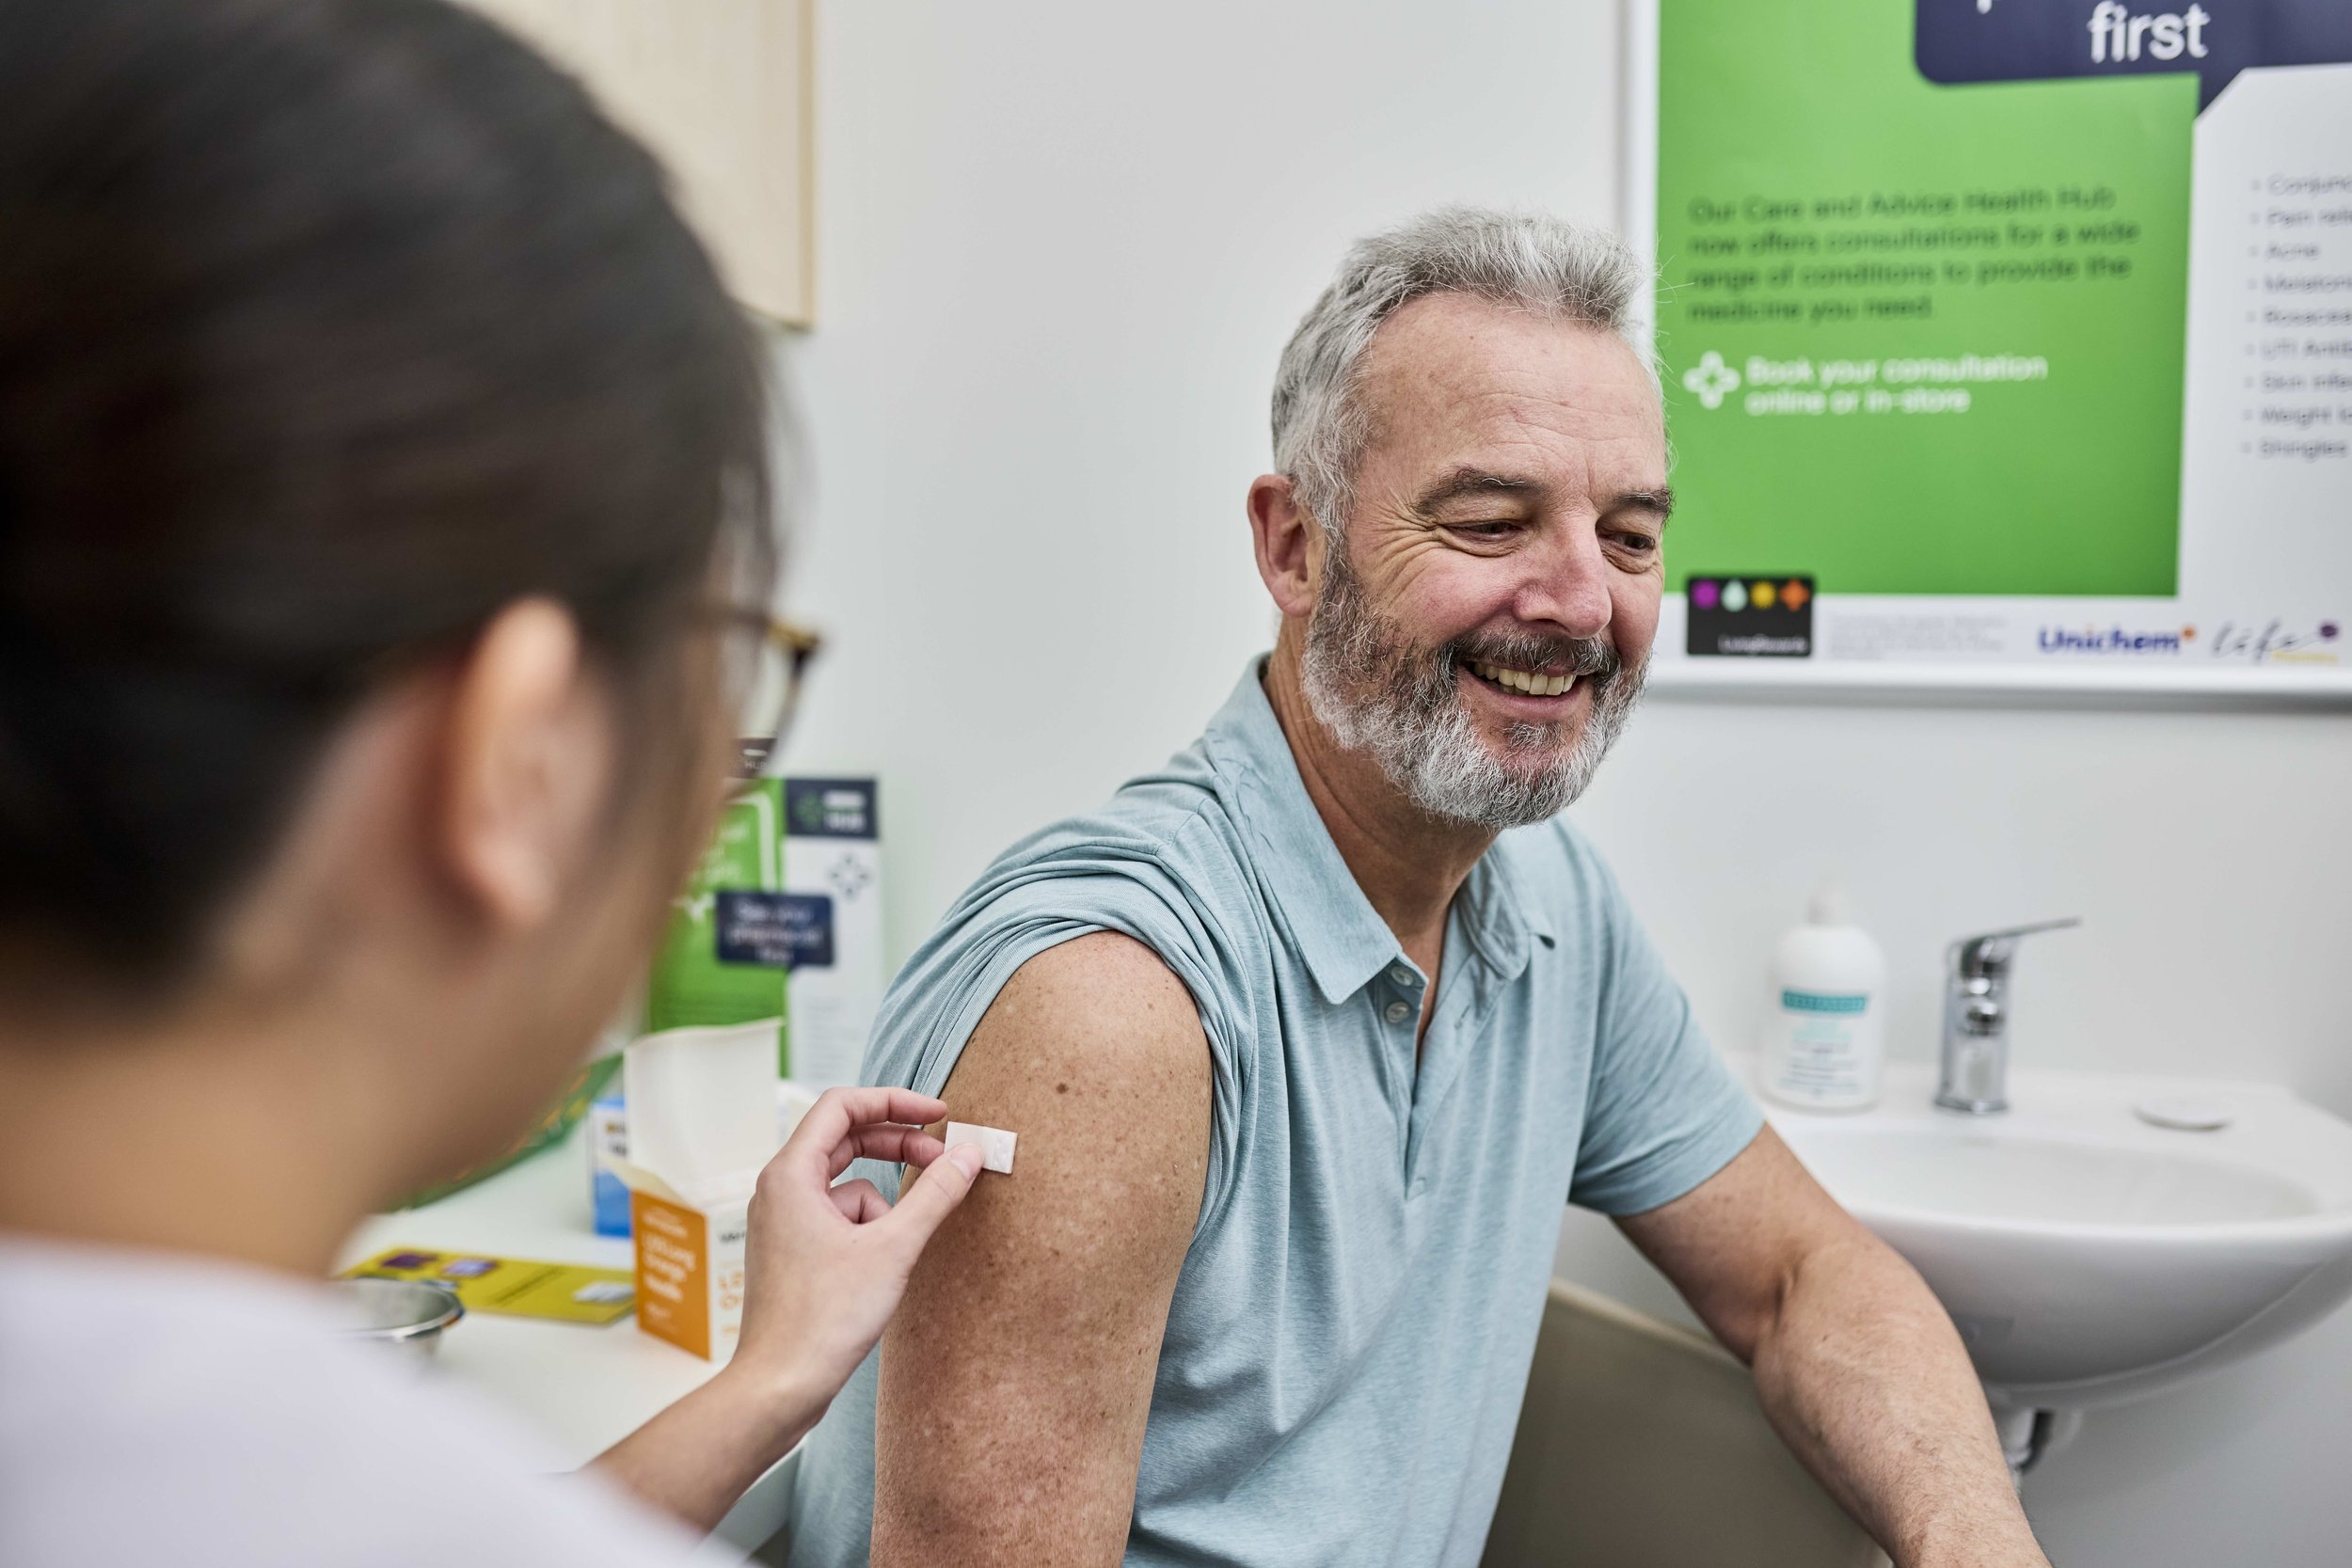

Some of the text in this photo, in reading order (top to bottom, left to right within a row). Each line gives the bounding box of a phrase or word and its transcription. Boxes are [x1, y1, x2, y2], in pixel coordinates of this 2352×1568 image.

[2087, 0, 2211, 64] first
[1689, 184, 2116, 224] Our Care and Advice Health Hub
[1825, 227, 2000, 254] consultations
[2007, 219, 2044, 248] for
[2076, 219, 2140, 245] wide
[1798, 261, 1936, 287] conditions
[1978, 258, 2080, 287] provide
[2085, 255, 2133, 280] the
[1745, 352, 2048, 390] Book your consultation
[1743, 386, 1972, 416] online or in-store
[2039, 624, 2181, 654] Unichem
